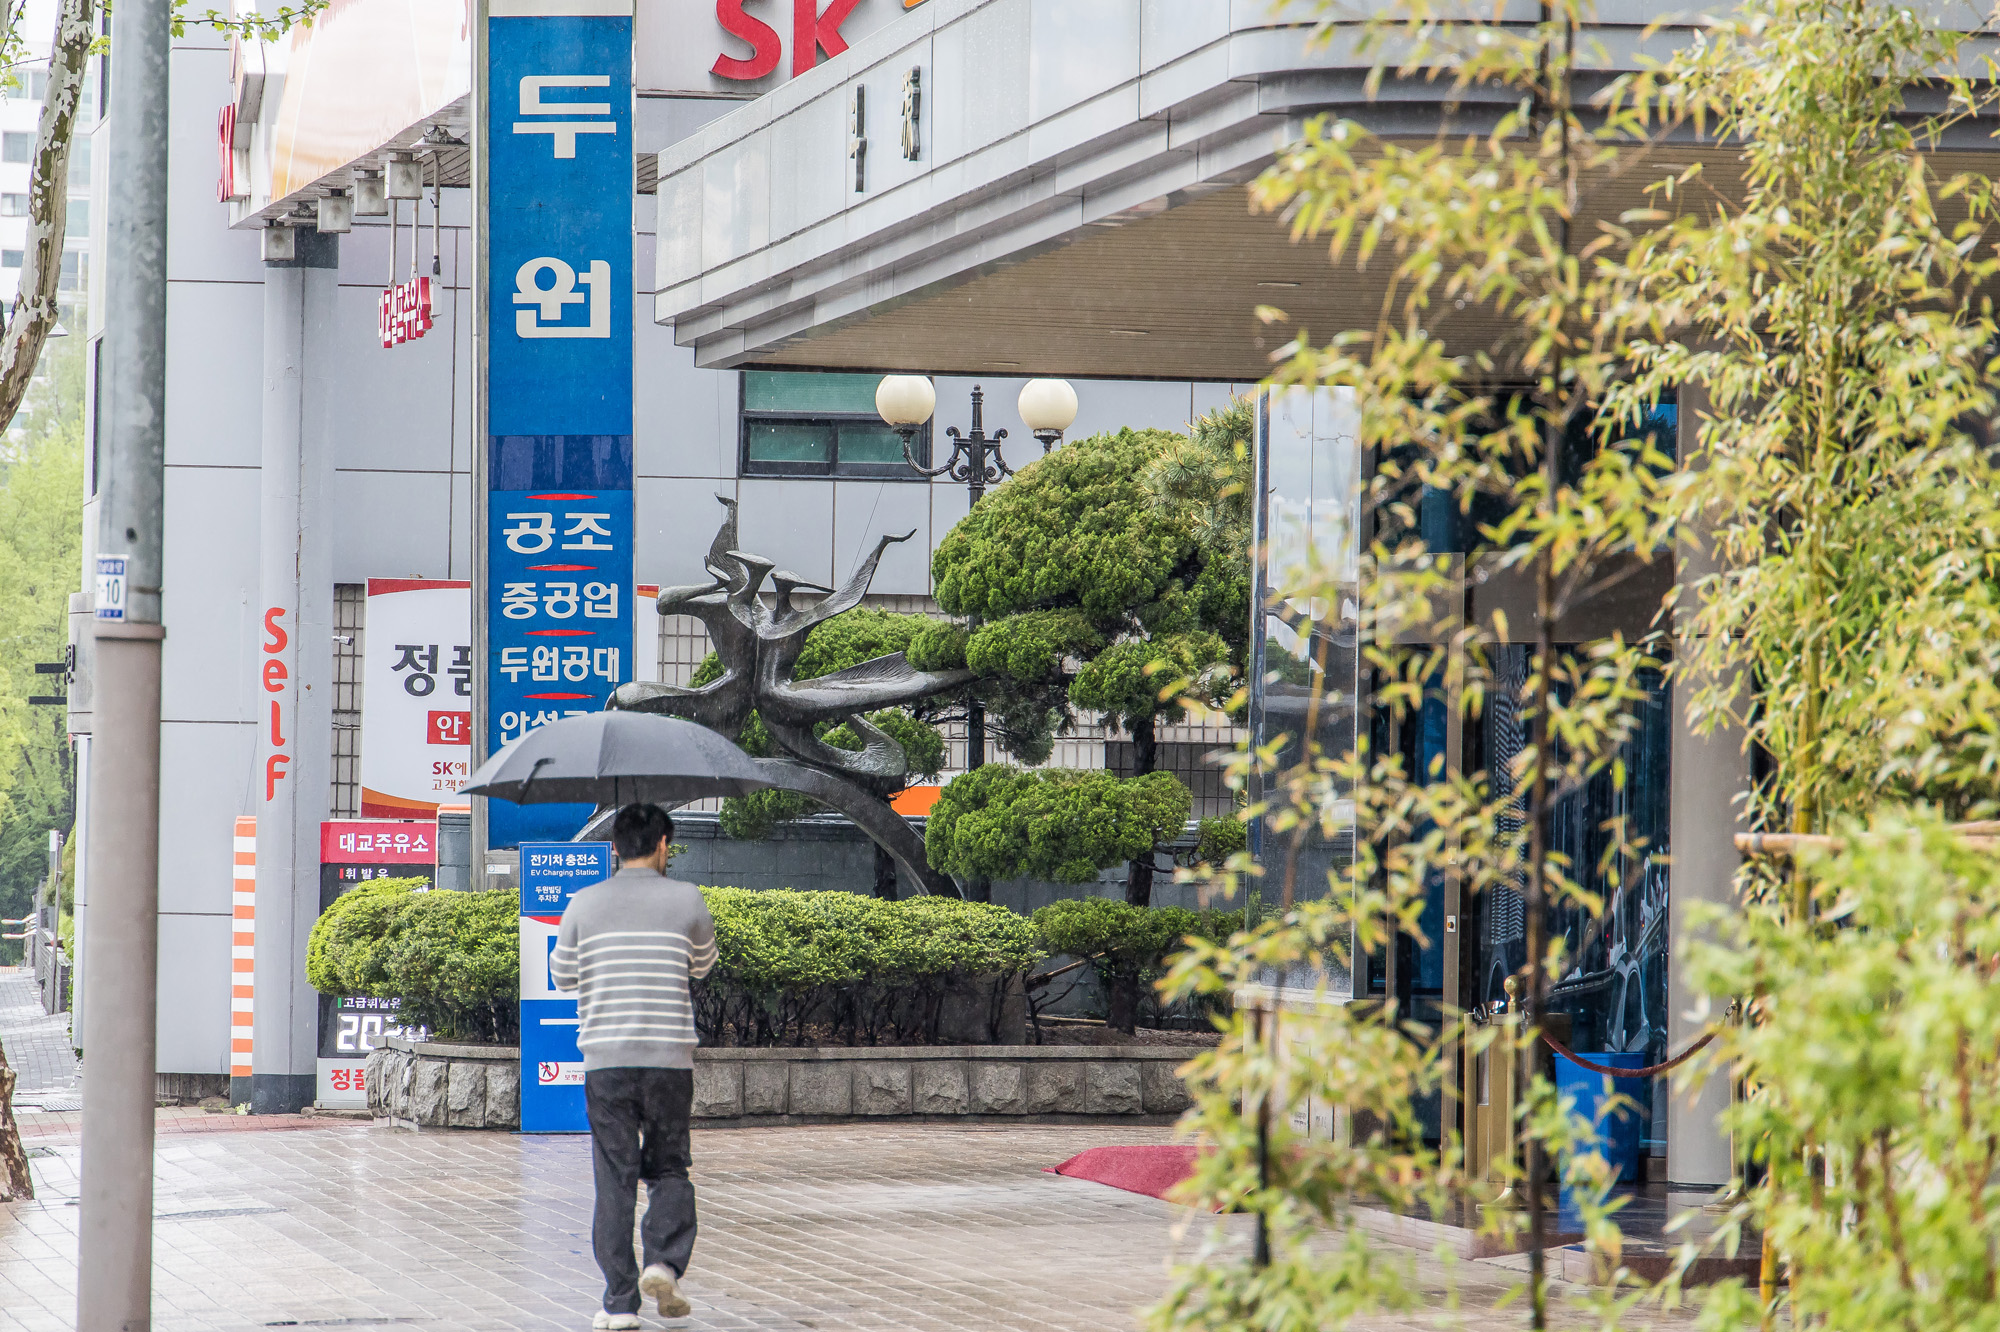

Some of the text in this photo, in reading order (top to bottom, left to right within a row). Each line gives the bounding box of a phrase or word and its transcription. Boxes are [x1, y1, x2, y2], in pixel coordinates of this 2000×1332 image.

[710, 0, 862, 81] SK
[502, 512, 614, 555] 공조
[501, 581, 619, 620] 중공업
[500, 645, 620, 683] 두원공대
[339, 832, 429, 854] 대교주유소
[530, 853, 599, 867] 전기차 충전소
[345, 867, 389, 880] 휘발유
[530, 868, 600, 878] EV Charging Station
[535, 886, 562, 895] 두원빌딩
[538, 894, 559, 903] 주차장
